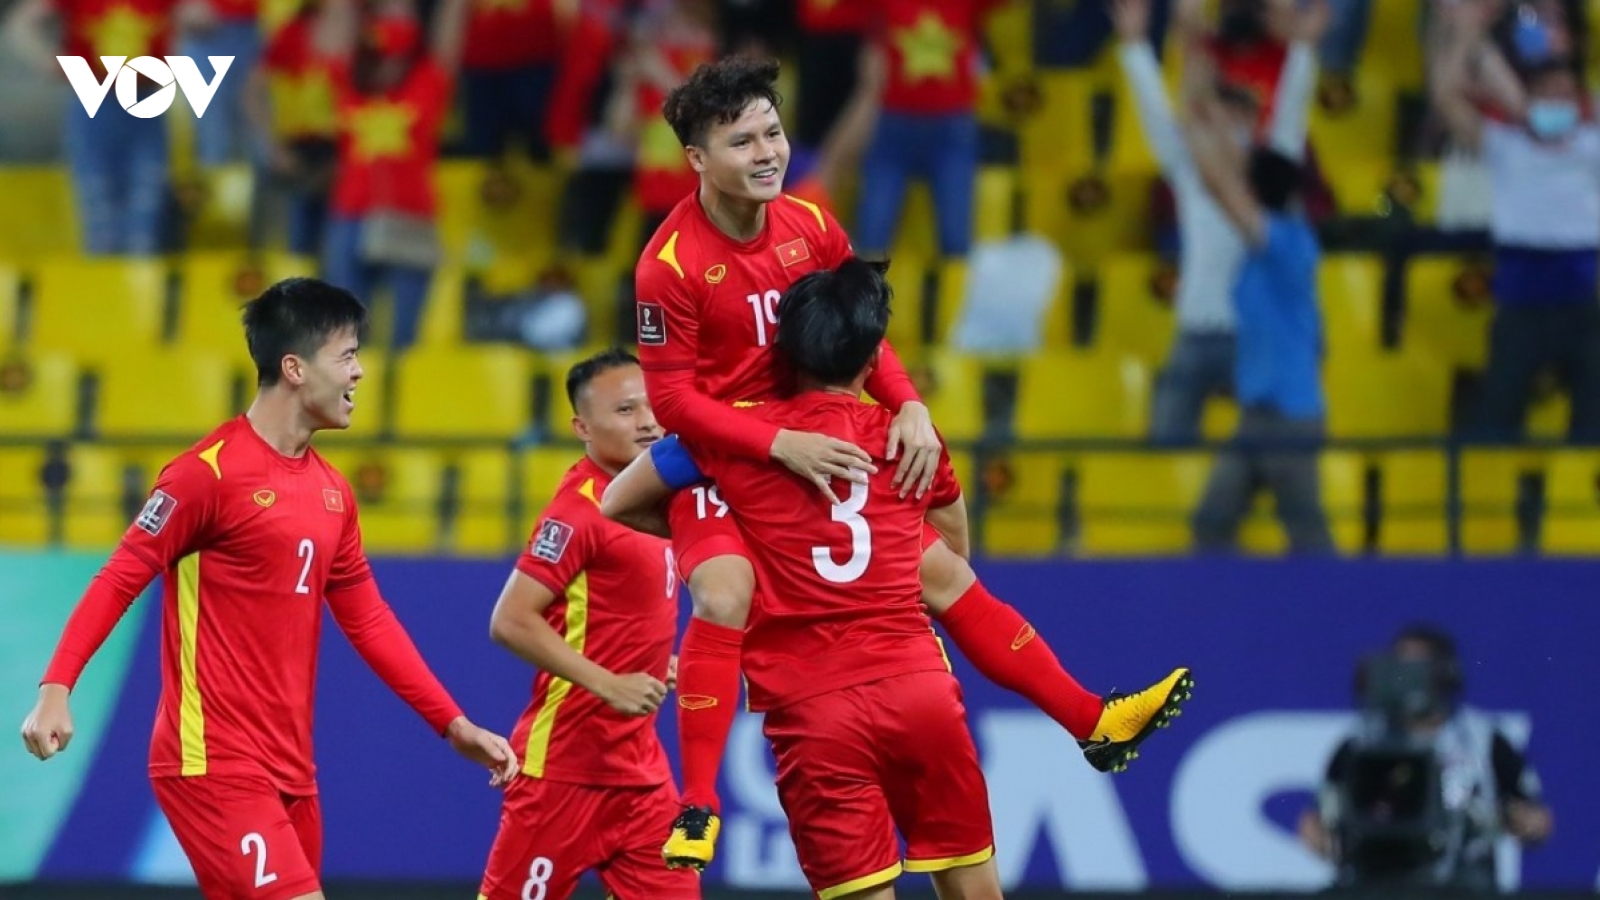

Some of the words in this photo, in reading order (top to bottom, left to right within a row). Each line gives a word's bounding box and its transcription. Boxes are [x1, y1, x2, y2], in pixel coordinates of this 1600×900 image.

[812, 465, 871, 582] 3
[295, 538, 314, 594] 2
[241, 832, 277, 888] 2
[521, 856, 553, 900] 8
